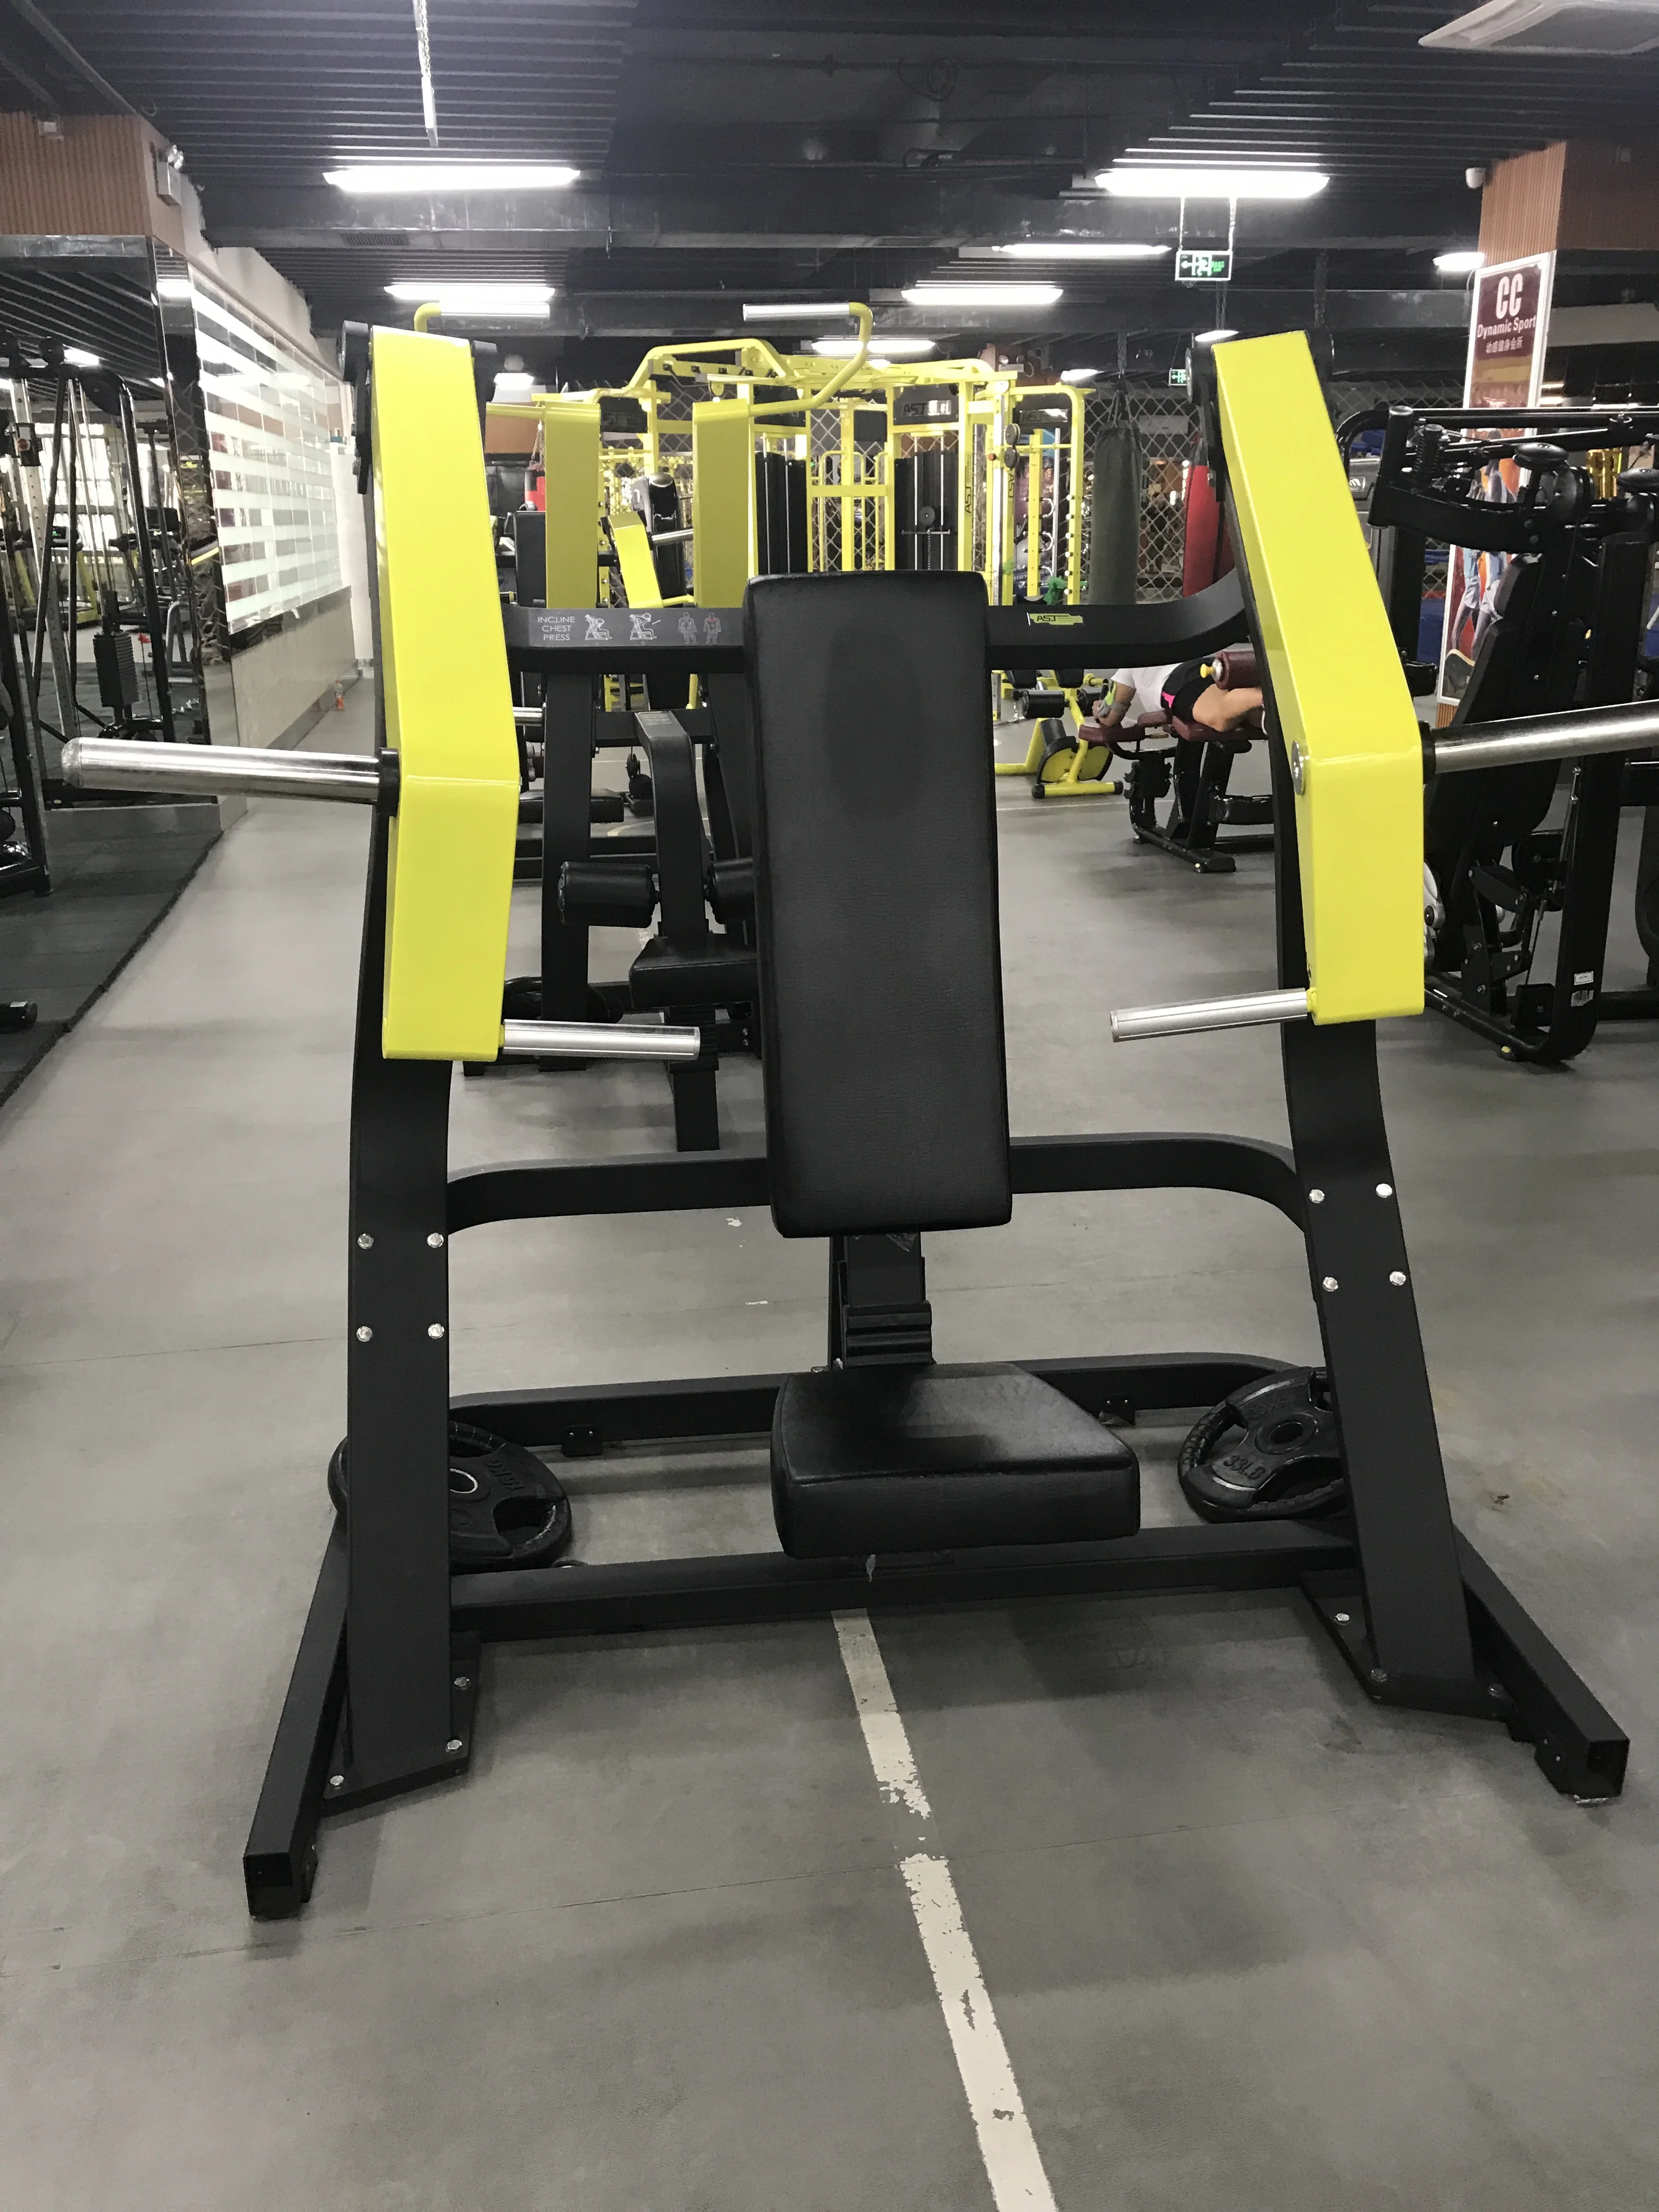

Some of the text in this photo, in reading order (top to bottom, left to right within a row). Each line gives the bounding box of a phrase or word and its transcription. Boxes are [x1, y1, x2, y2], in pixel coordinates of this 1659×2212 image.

[1496, 273, 1523, 319] CC
[1477, 315, 1537, 340] Dynamic Sport
[543, 633, 571, 641] PRESS
[1223, 1454, 1267, 1481] 33LB
